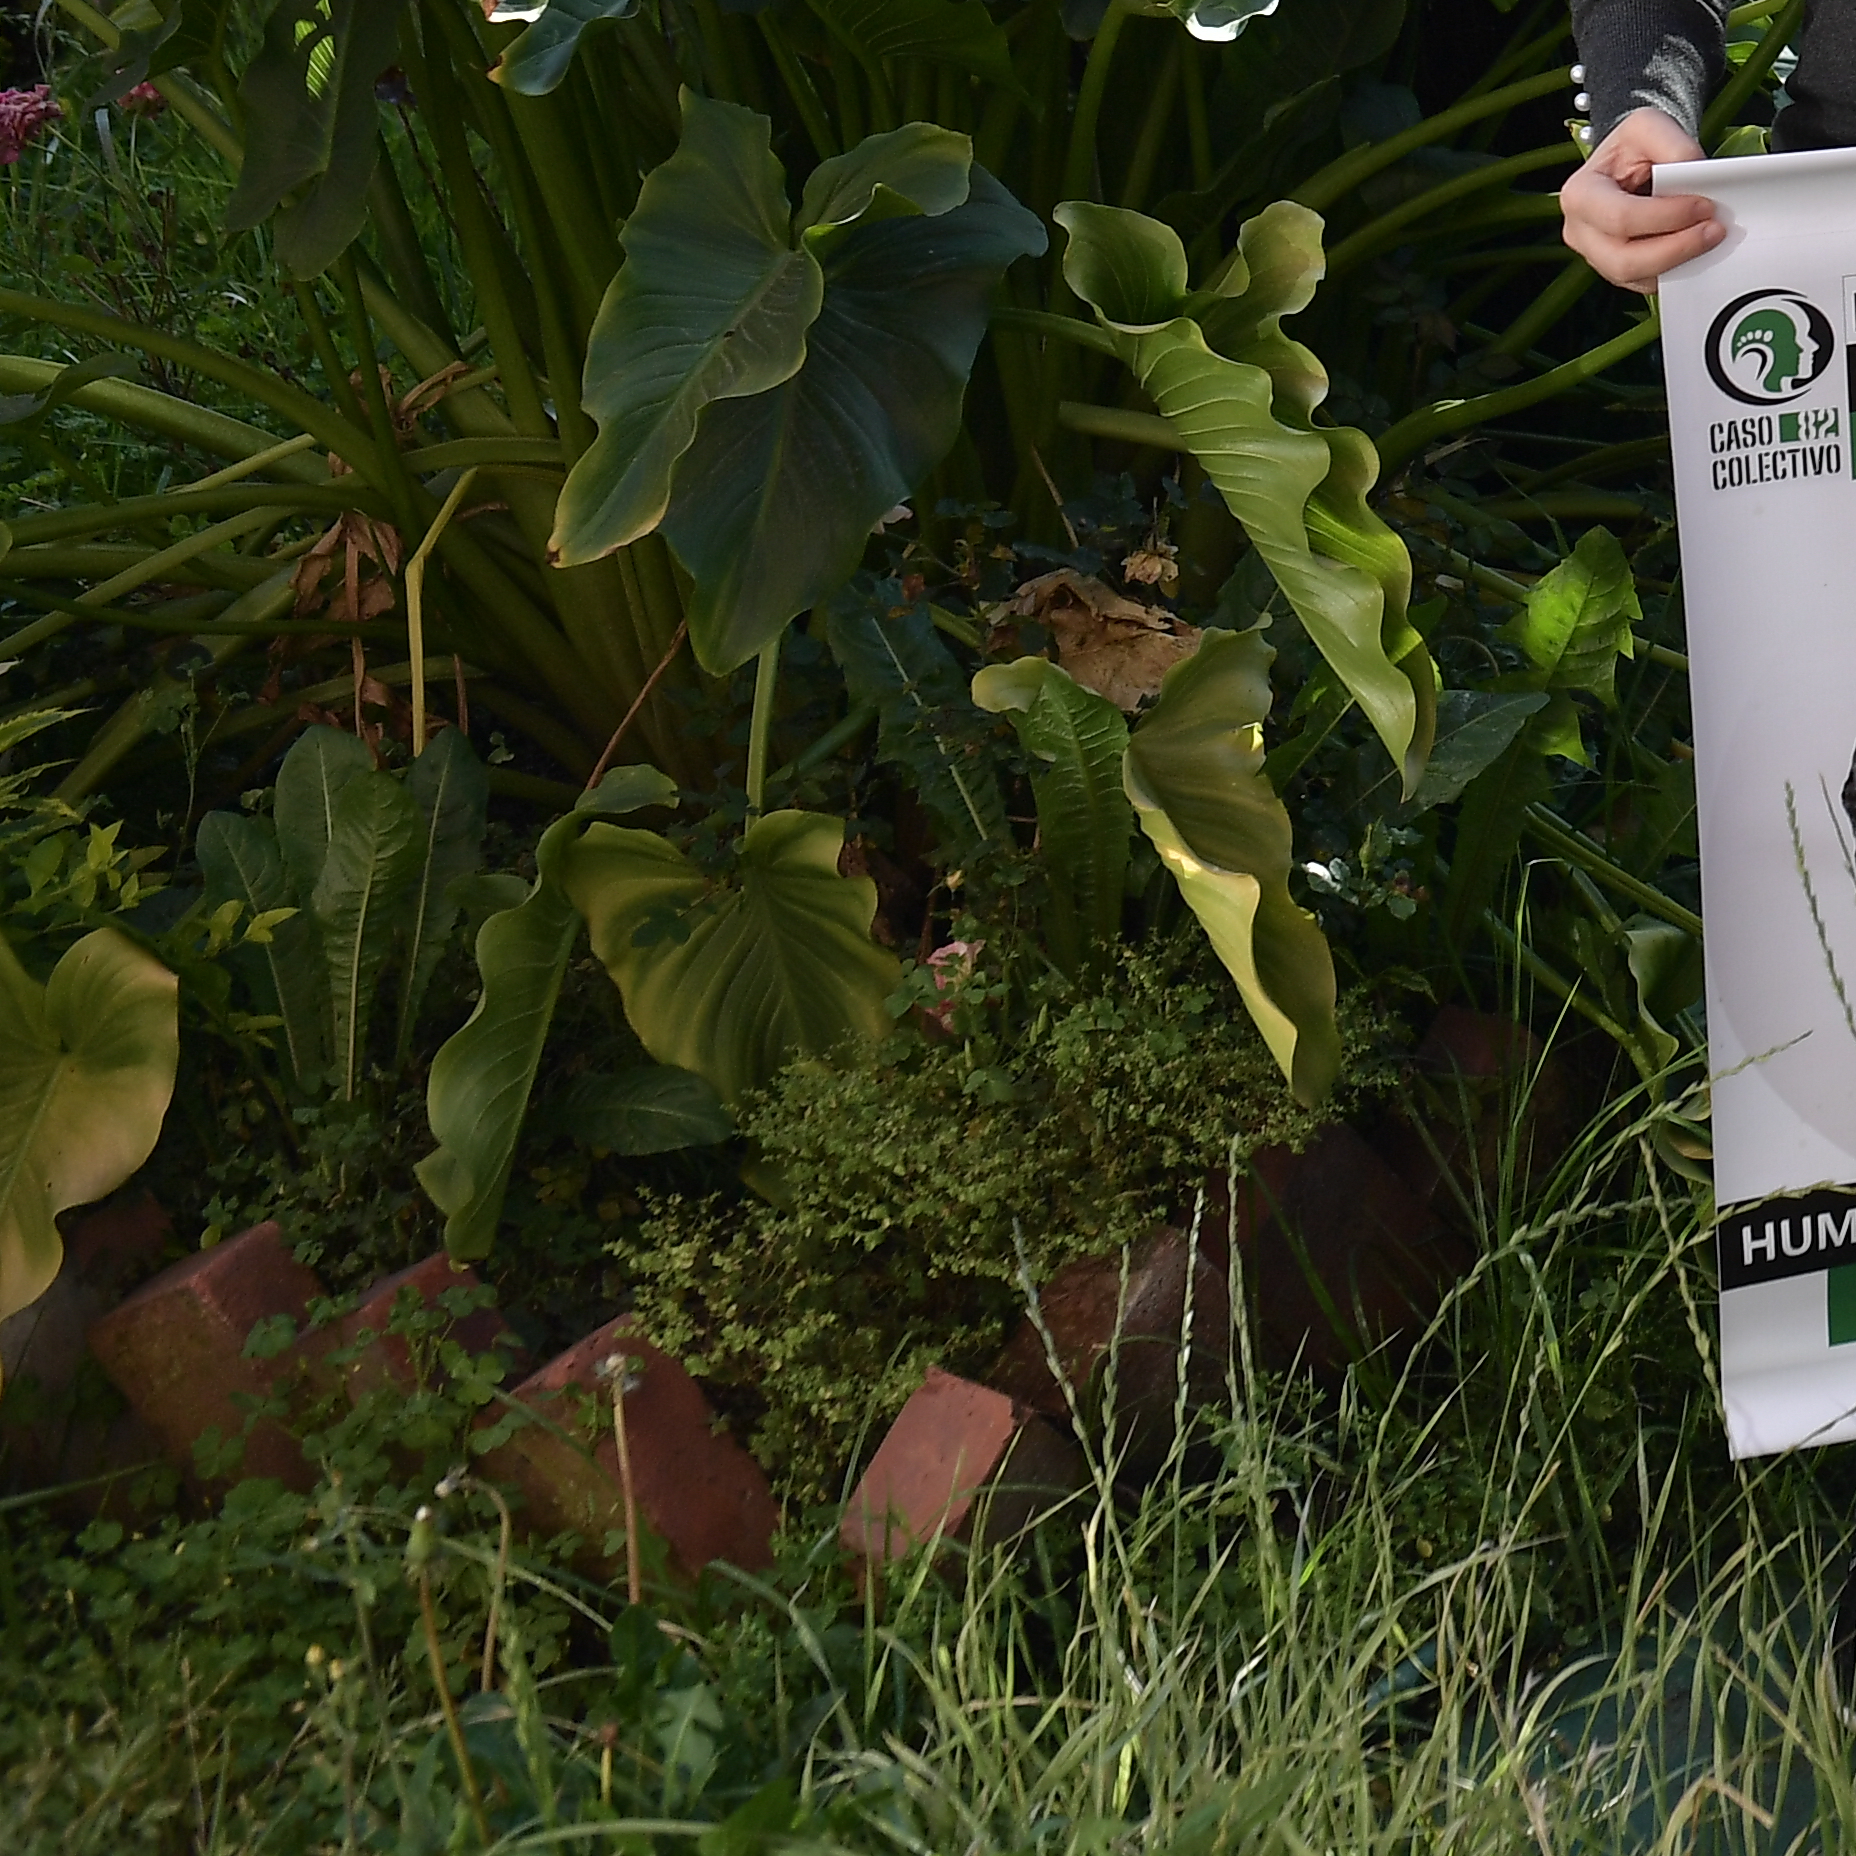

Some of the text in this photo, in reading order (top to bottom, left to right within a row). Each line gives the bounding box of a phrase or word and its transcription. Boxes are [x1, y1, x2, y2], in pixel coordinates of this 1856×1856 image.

[1710, 407, 1839, 454] CASO 82
[1712, 444, 1841, 491] COLECTIVO
